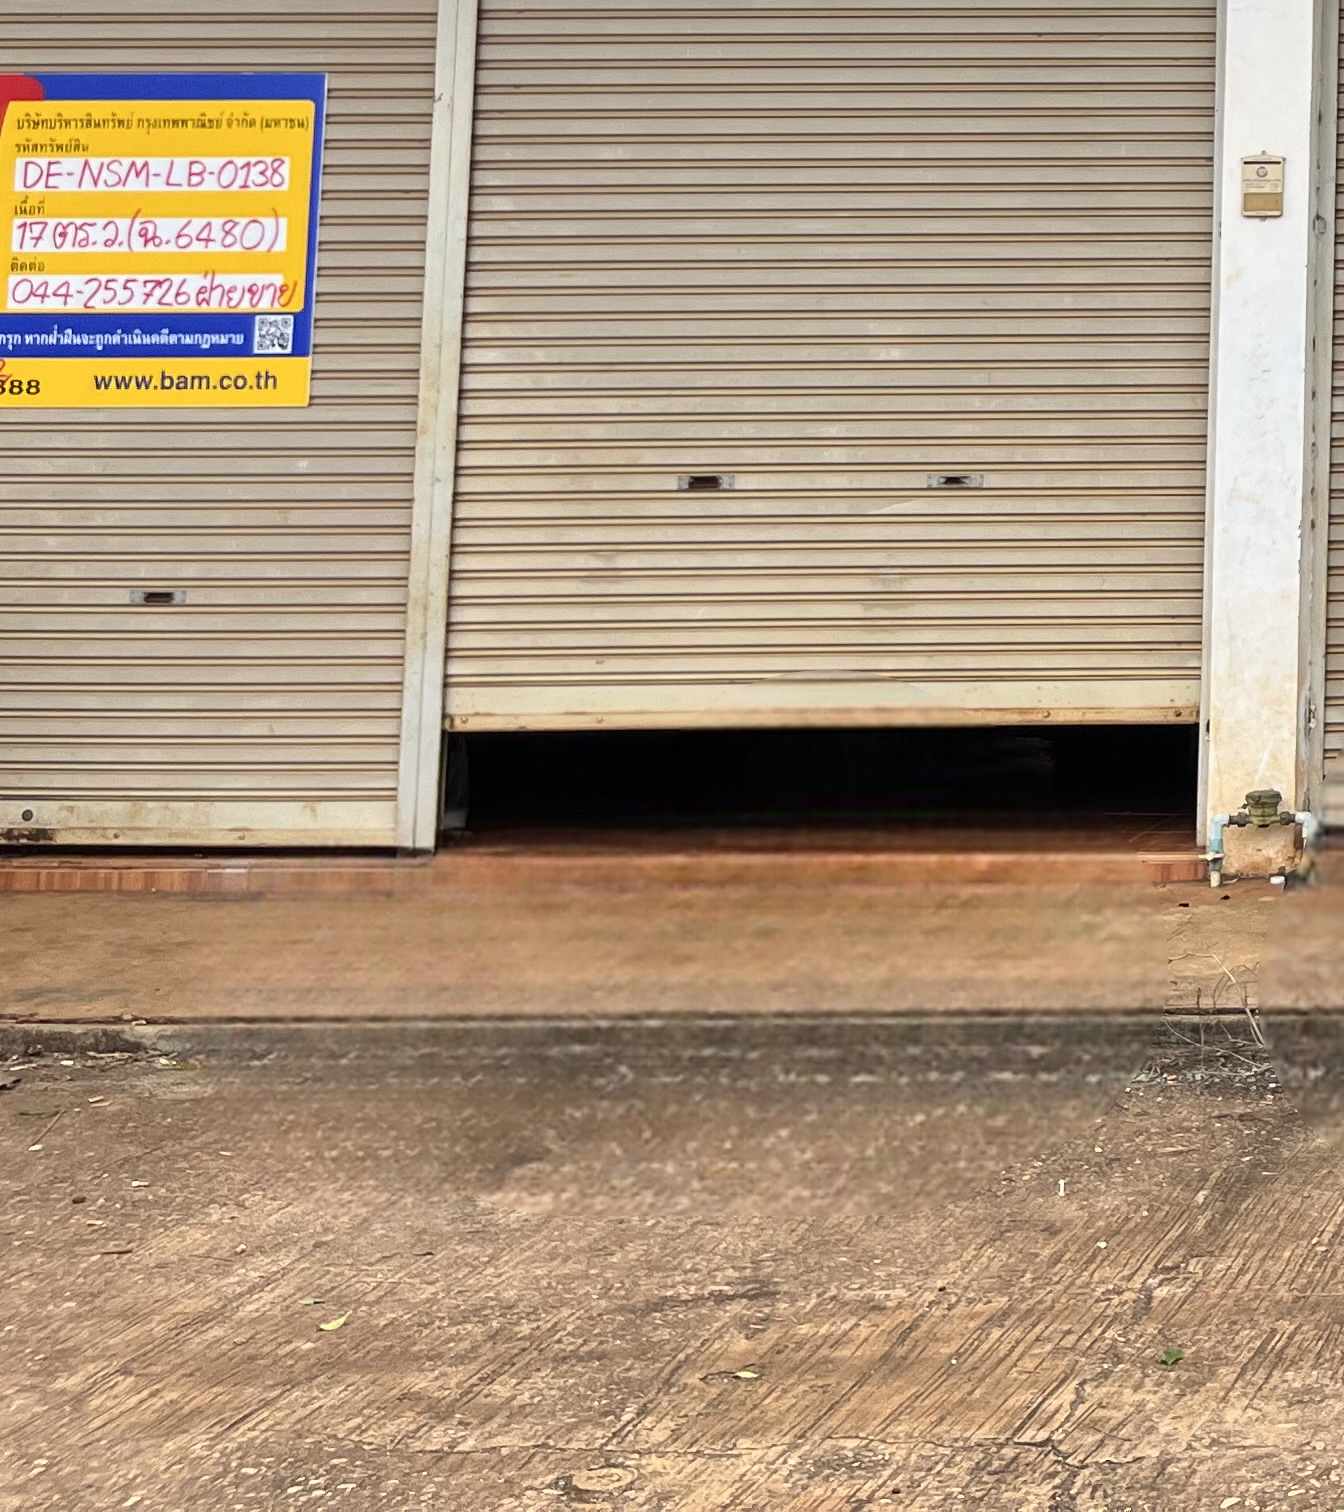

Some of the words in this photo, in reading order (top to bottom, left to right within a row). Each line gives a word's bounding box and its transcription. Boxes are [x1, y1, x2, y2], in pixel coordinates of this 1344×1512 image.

[137, 113, 223, 135] กรุงเทพพาณิชย์
[226, 113, 257, 129] จำกัด
[260, 116, 310, 131] (มหาชน)
[15, 138, 89, 154] รหัสทรัพย์สิน
[22, 158, 286, 189] DE-NSM-LB-0138
[14, 194, 46, 216] เนื้อที่
[10, 257, 45, 272] ติดต่อ
[11, 278, 191, 309] 044-255726
[93, 371, 278, 391] www.bam.co.th
